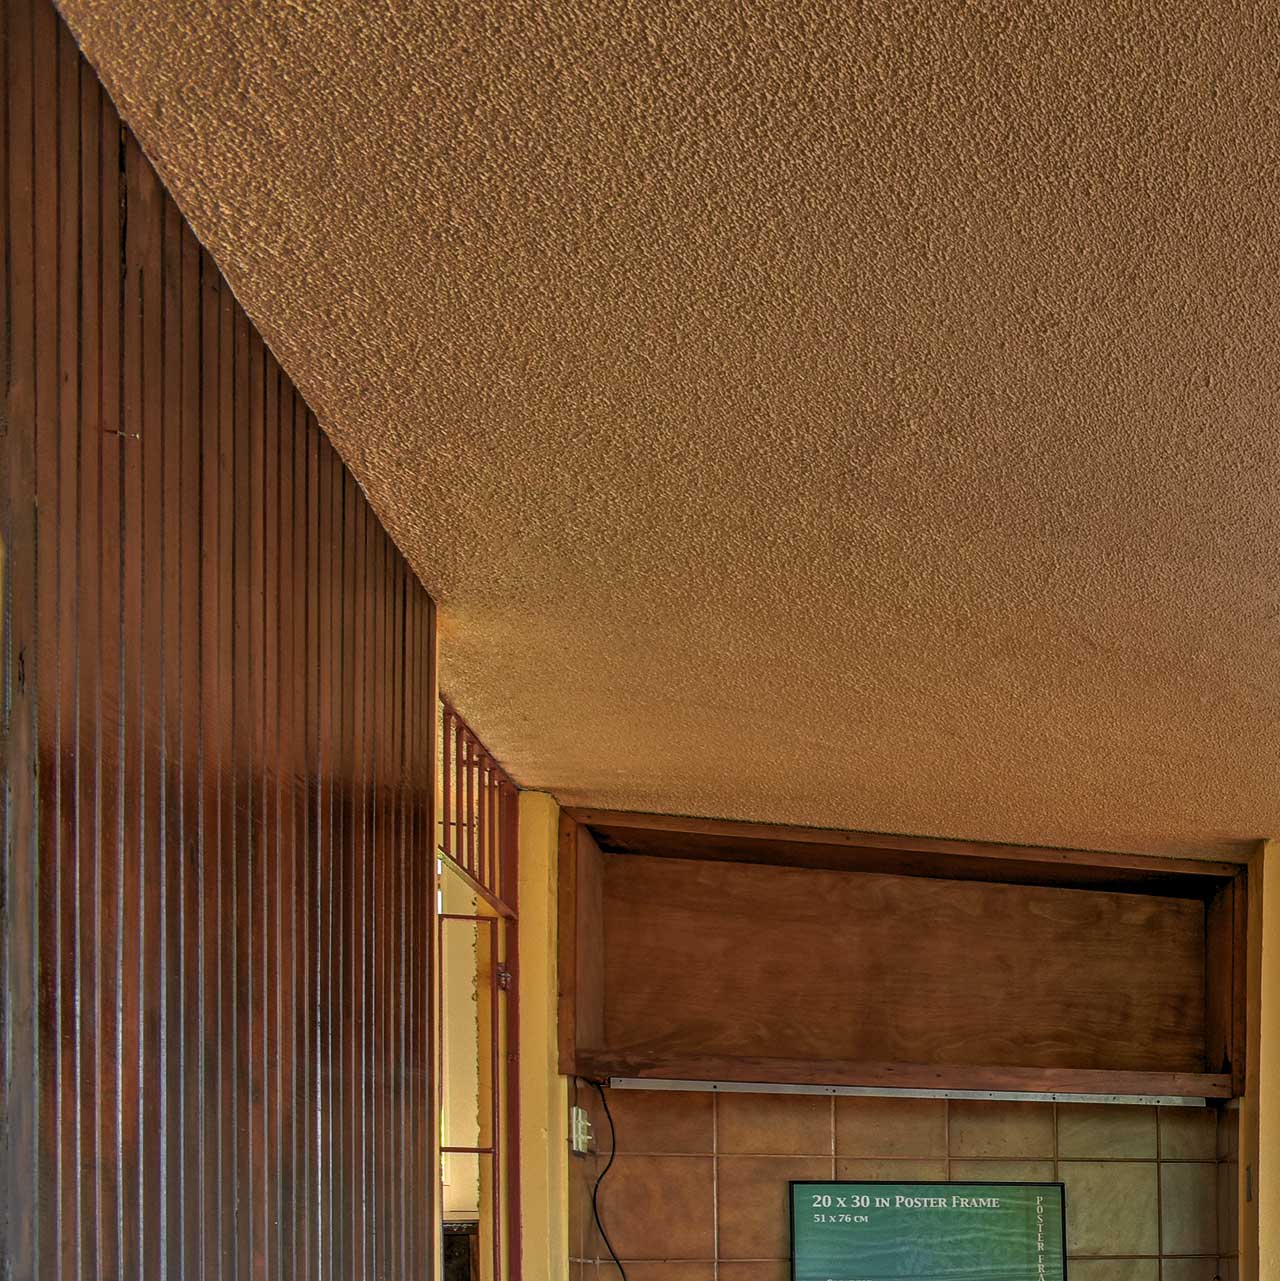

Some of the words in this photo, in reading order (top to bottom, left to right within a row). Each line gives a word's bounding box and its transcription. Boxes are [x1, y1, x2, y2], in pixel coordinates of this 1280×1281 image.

[812, 1194, 832, 1208] 20
[851, 1194, 870, 1208] 30
[875, 1197, 890, 1208] IN
[895, 1195, 947, 1208] POSTER
[951, 1195, 1000, 1208] FRAME
[813, 1214, 826, 1223] 51
[838, 1214, 851, 1223] 76
